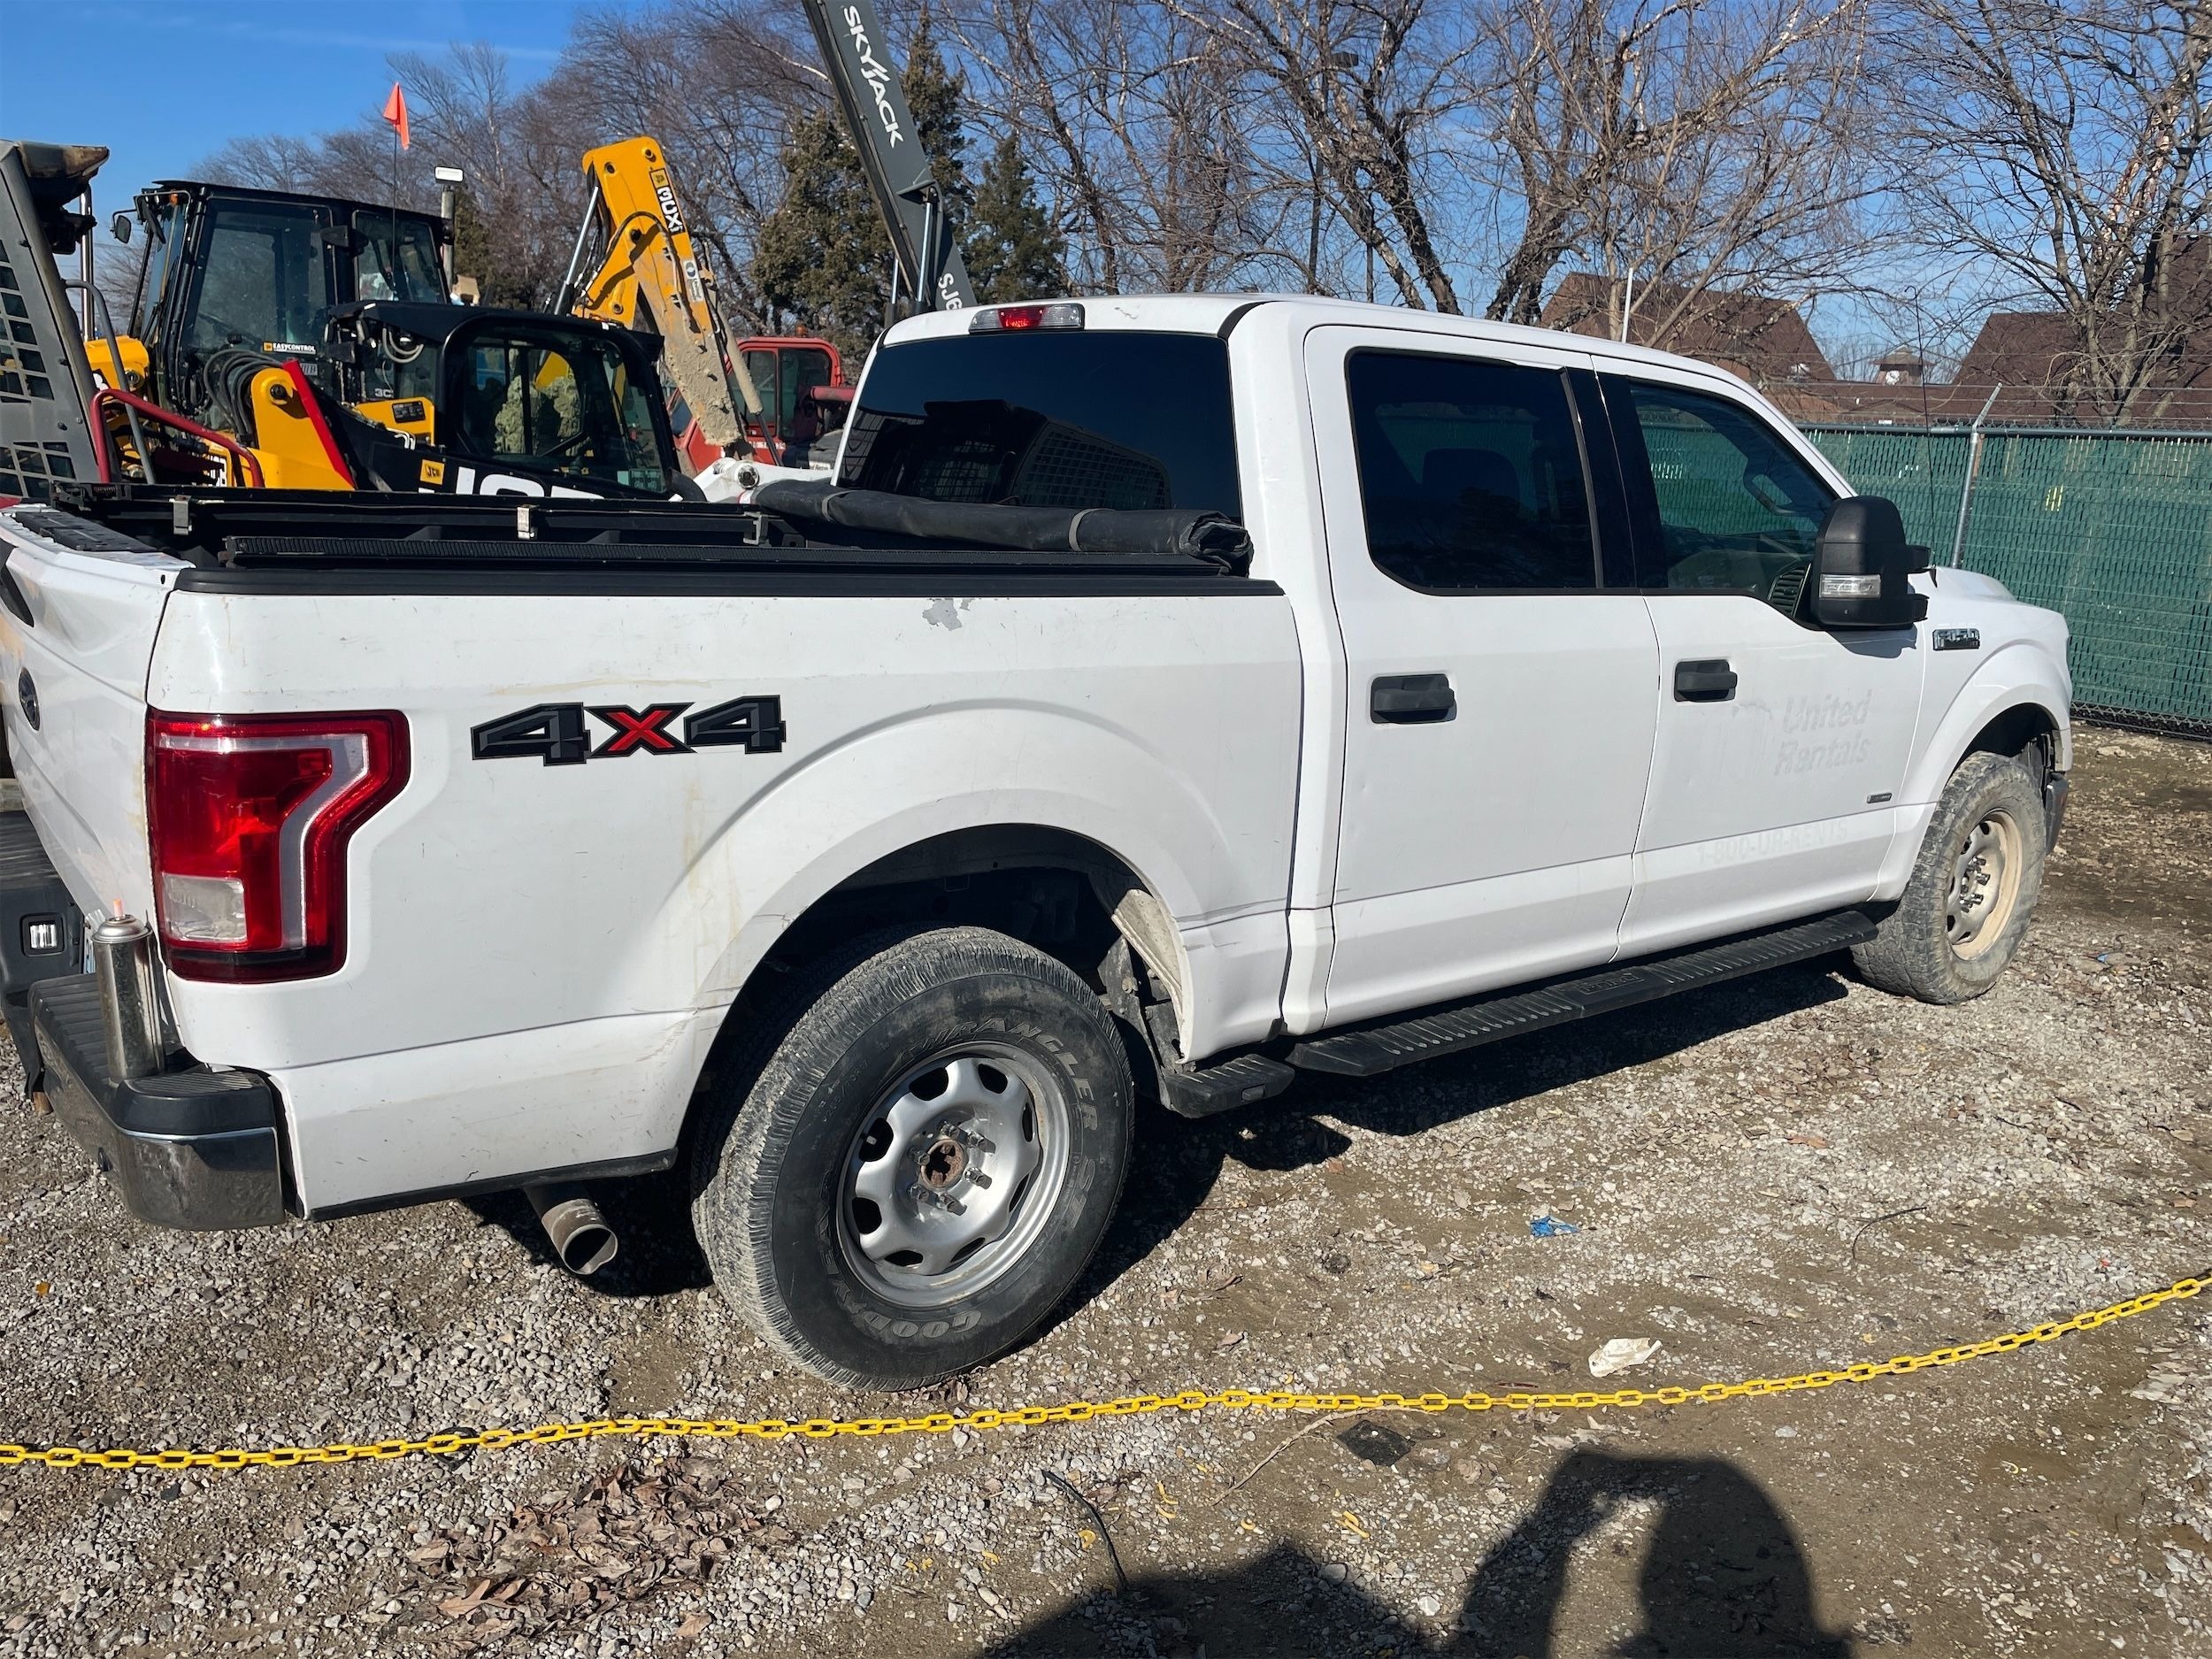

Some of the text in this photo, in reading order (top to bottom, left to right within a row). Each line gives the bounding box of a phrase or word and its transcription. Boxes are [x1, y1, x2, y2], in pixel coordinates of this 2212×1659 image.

[842, 4, 904, 149] SKYJACK
[657, 186, 683, 230] 3CX
[273, 342, 316, 352] EASYCONTROL
[1782, 688, 1874, 733] United
[1773, 730, 1870, 777] Rentals
[1695, 818, 1849, 868] 1-800-UR-RENTS
